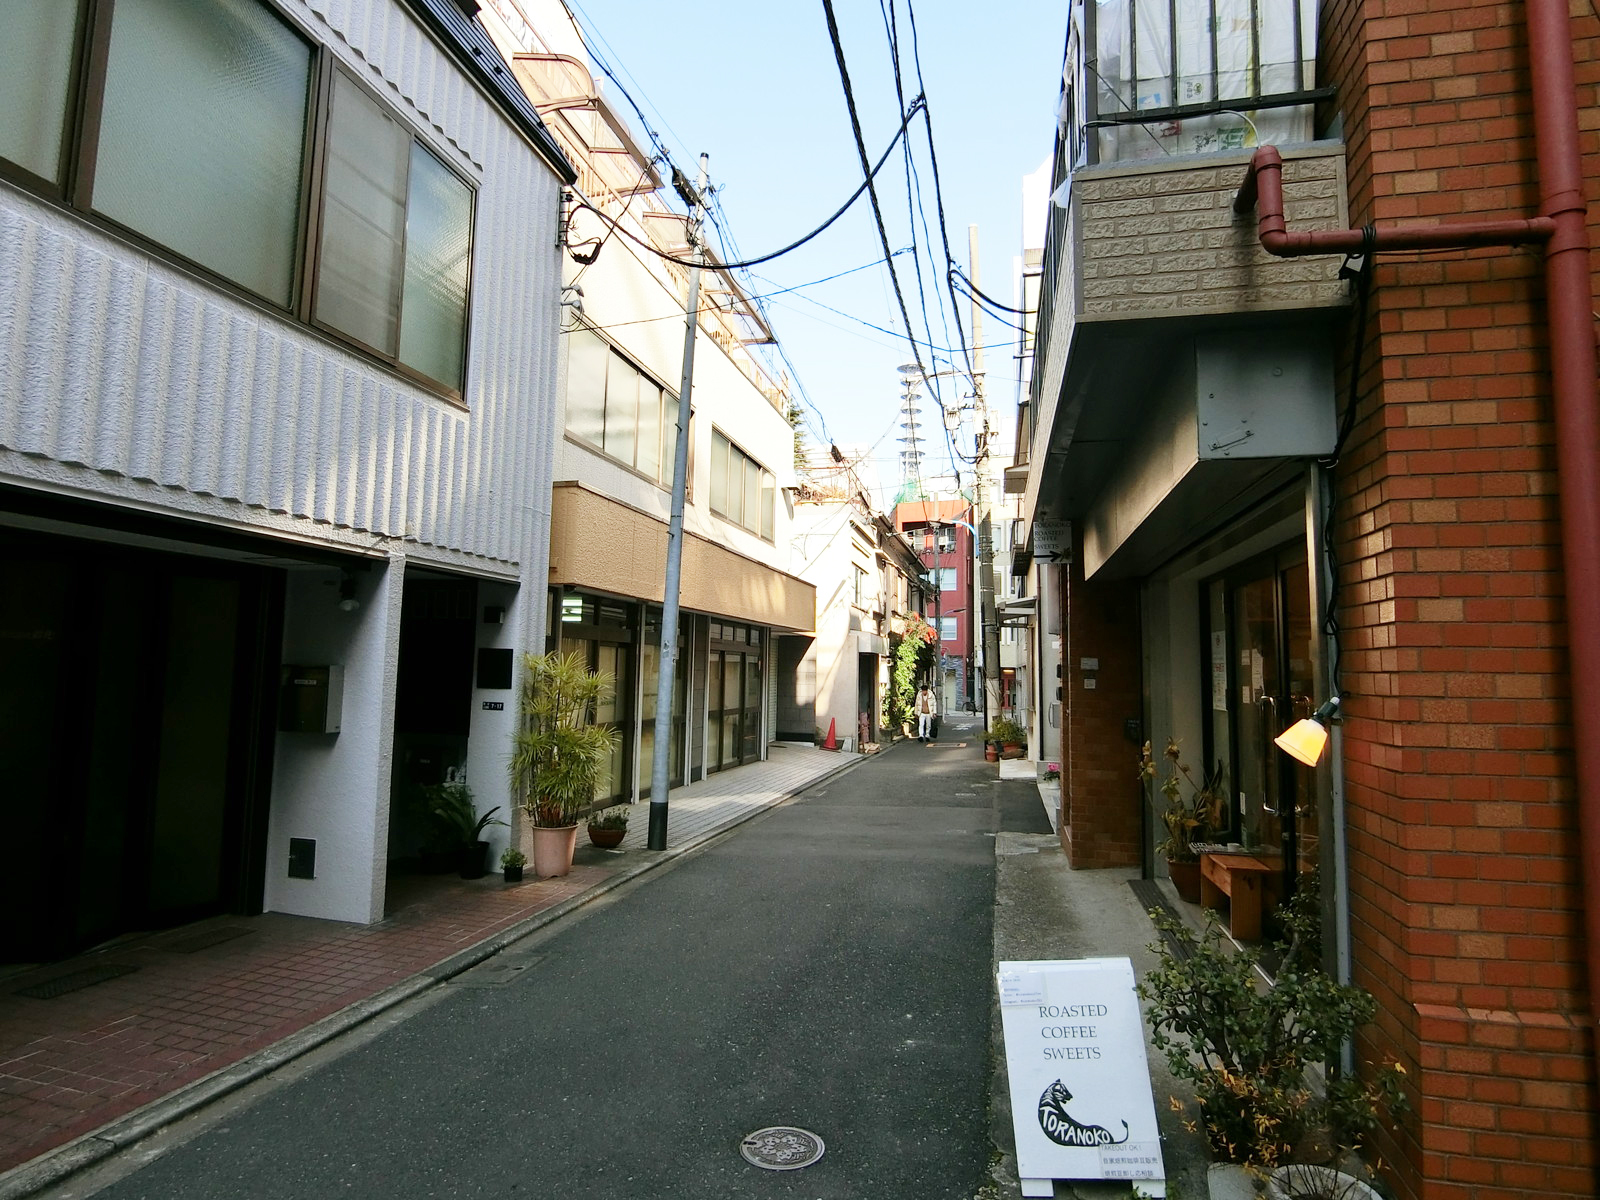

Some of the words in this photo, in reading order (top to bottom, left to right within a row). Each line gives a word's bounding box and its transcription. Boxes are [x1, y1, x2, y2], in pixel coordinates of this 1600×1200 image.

[1039, 1005, 1107, 1018] ROASTED
[1041, 1026, 1097, 1038] COFFEE
[1043, 1047, 1101, 1060] SWEETS
[1039, 1106, 1110, 1145] TORANOKO
[1101, 1144, 1128, 1152] TAKEOUT
